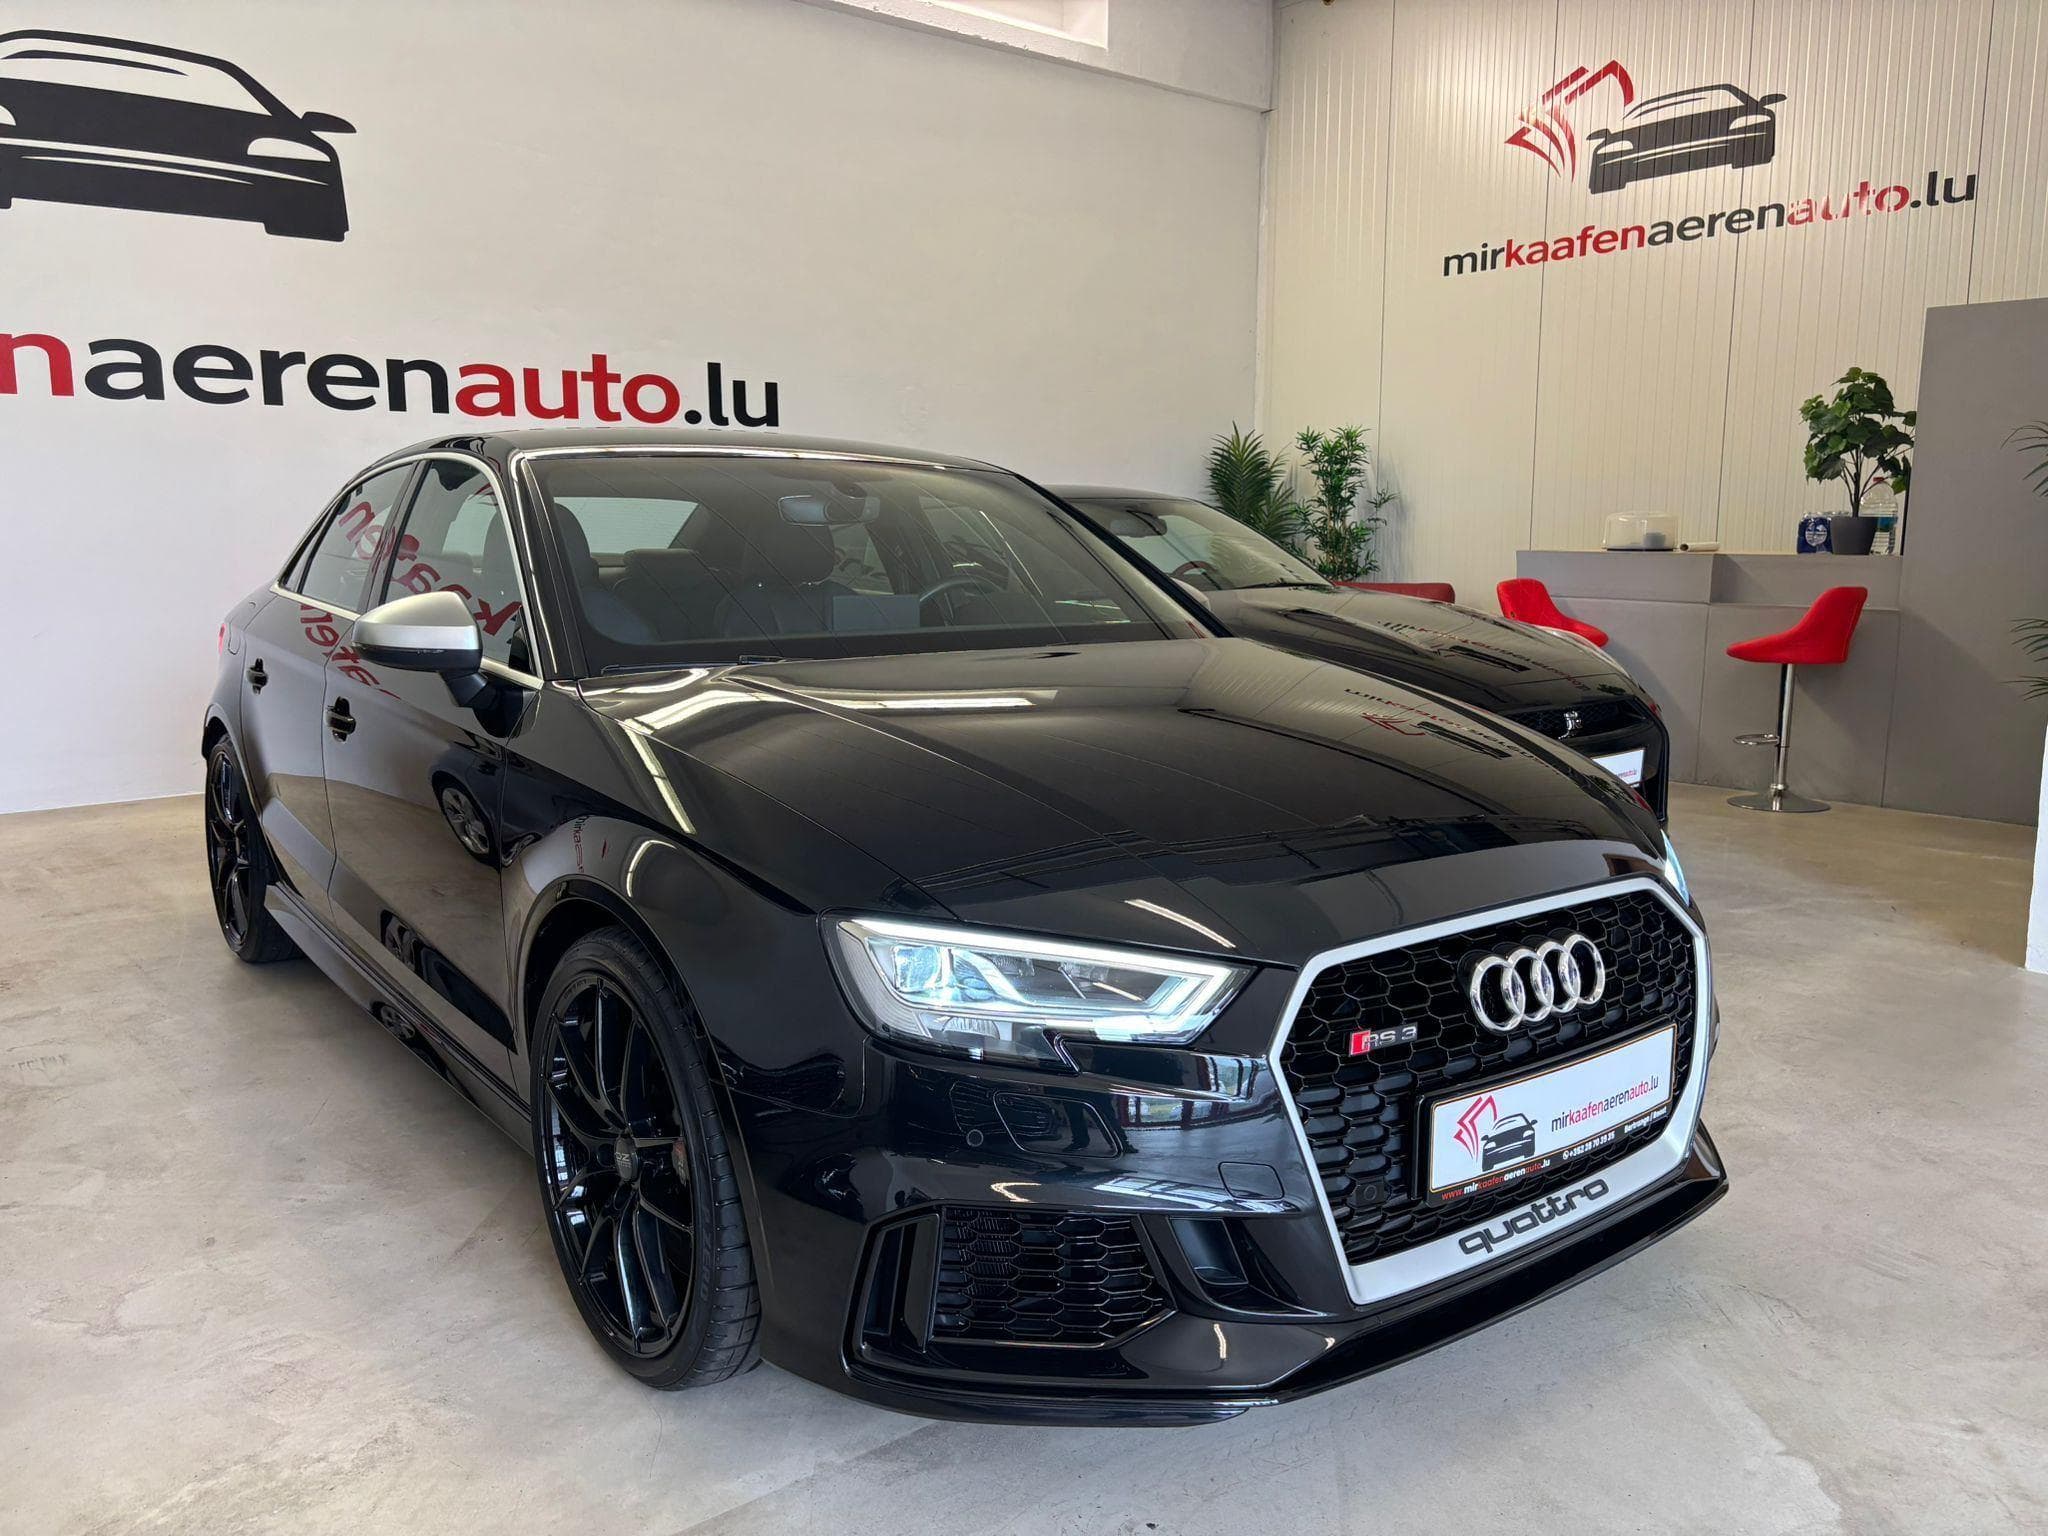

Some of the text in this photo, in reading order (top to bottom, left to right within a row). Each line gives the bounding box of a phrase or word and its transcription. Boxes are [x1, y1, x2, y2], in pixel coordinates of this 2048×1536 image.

[1442, 171, 1977, 277] mirkaafenaerenauto.lu
[1551, 1075, 1659, 1132] mirkaafenaerenauto.lu
[1458, 1178, 1609, 1255] quattro
